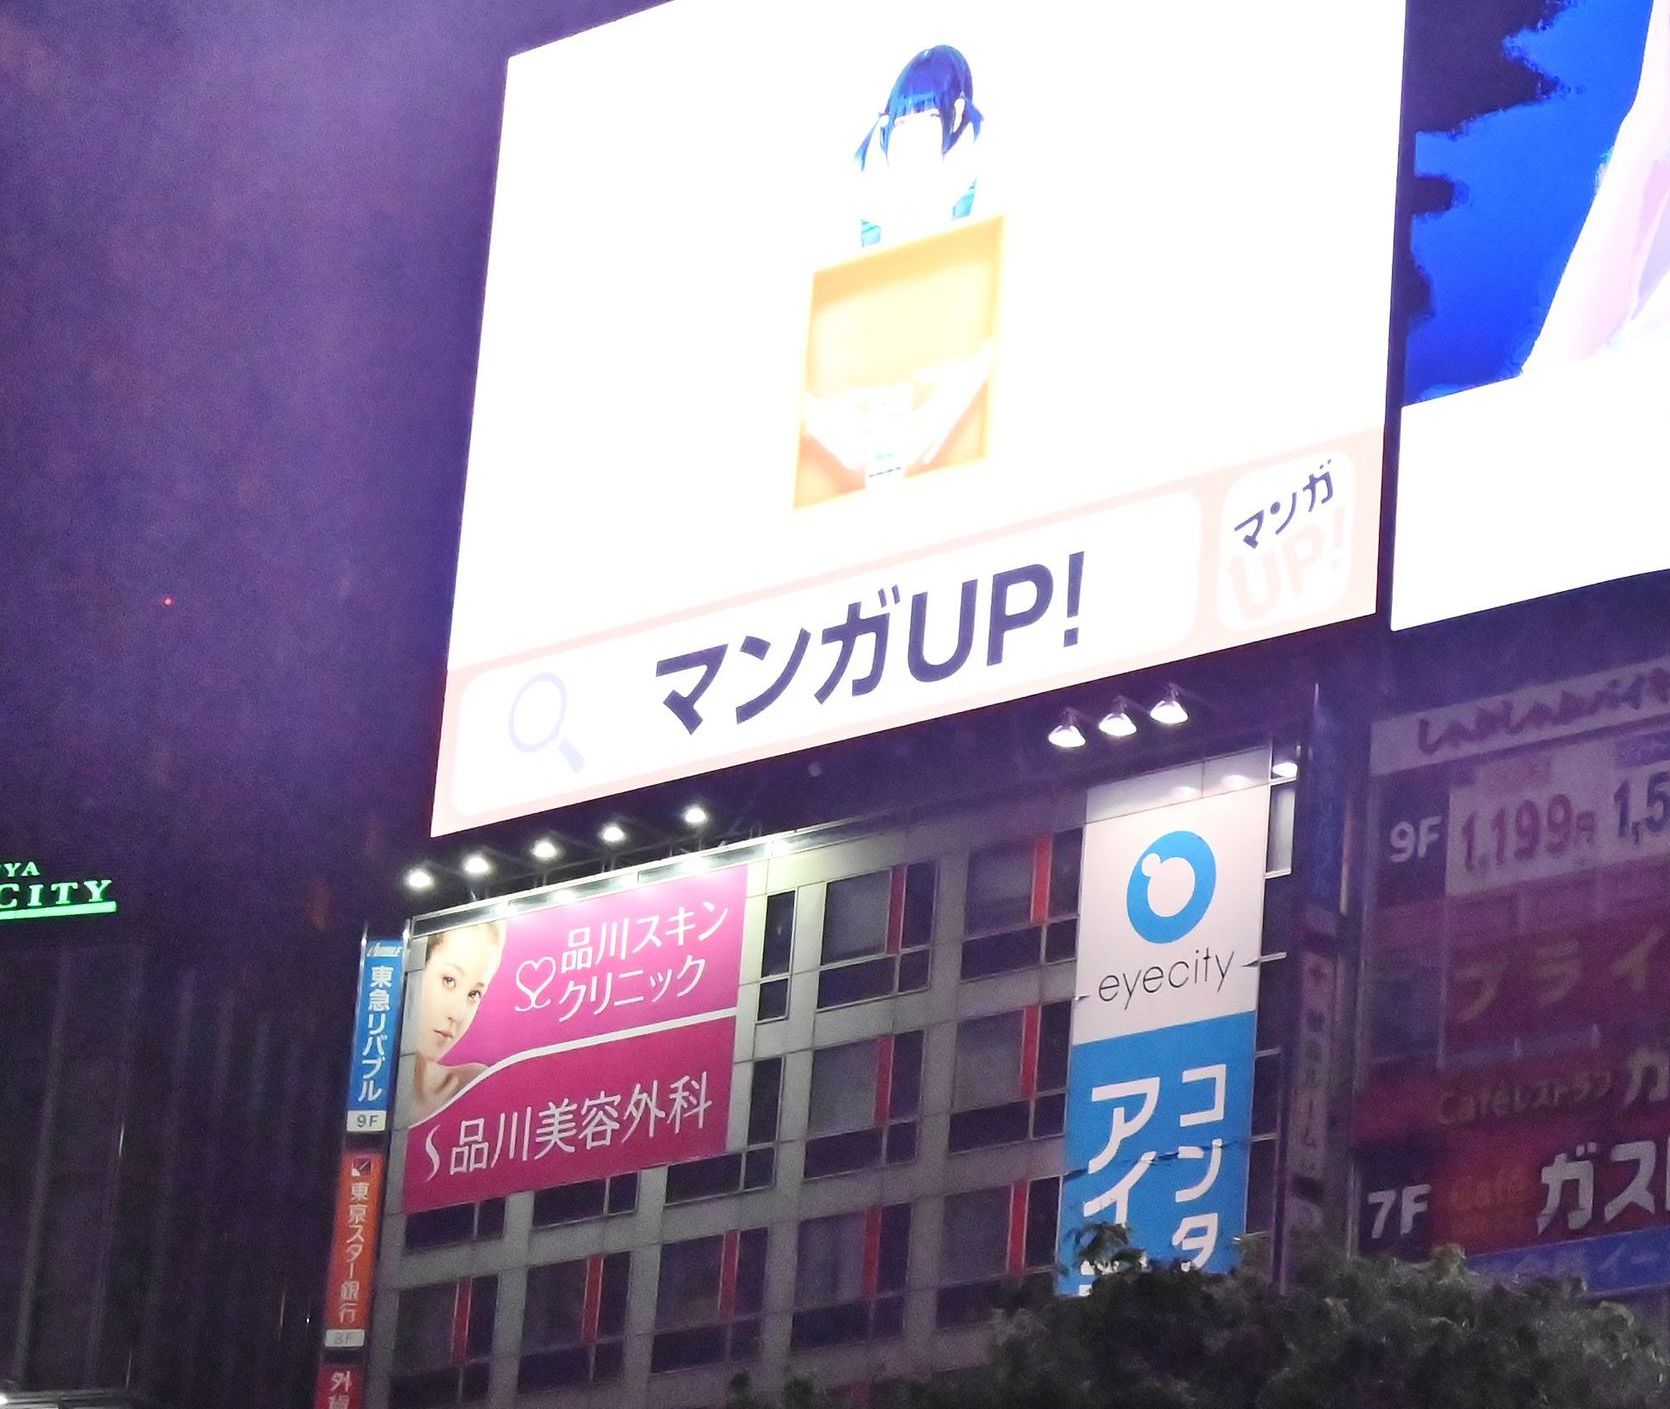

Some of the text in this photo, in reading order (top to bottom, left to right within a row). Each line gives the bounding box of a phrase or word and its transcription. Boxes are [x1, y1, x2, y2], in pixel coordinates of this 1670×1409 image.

[1234, 459, 1336, 550] マンガ
[1225, 503, 1349, 625] UP!
[655, 550, 1087, 735] マンガUP!
[0, 861, 41, 878] YA
[1388, 815, 1442, 863] 9F
[0, 879, 113, 909] CITY
[560, 900, 730, 972] 品川スキン
[559, 955, 706, 1025] クリニック
[1098, 946, 1235, 1011] eyecity
[357, 965, 395, 1103] 東急リバブル
[356, 1114, 379, 1128] 9F
[448, 1070, 714, 1174] 品川美容外科
[1078, 1075, 1160, 1297] アイ
[1366, 1183, 1433, 1240] 7F
[338, 1181, 370, 1324] 東京スター銀行
